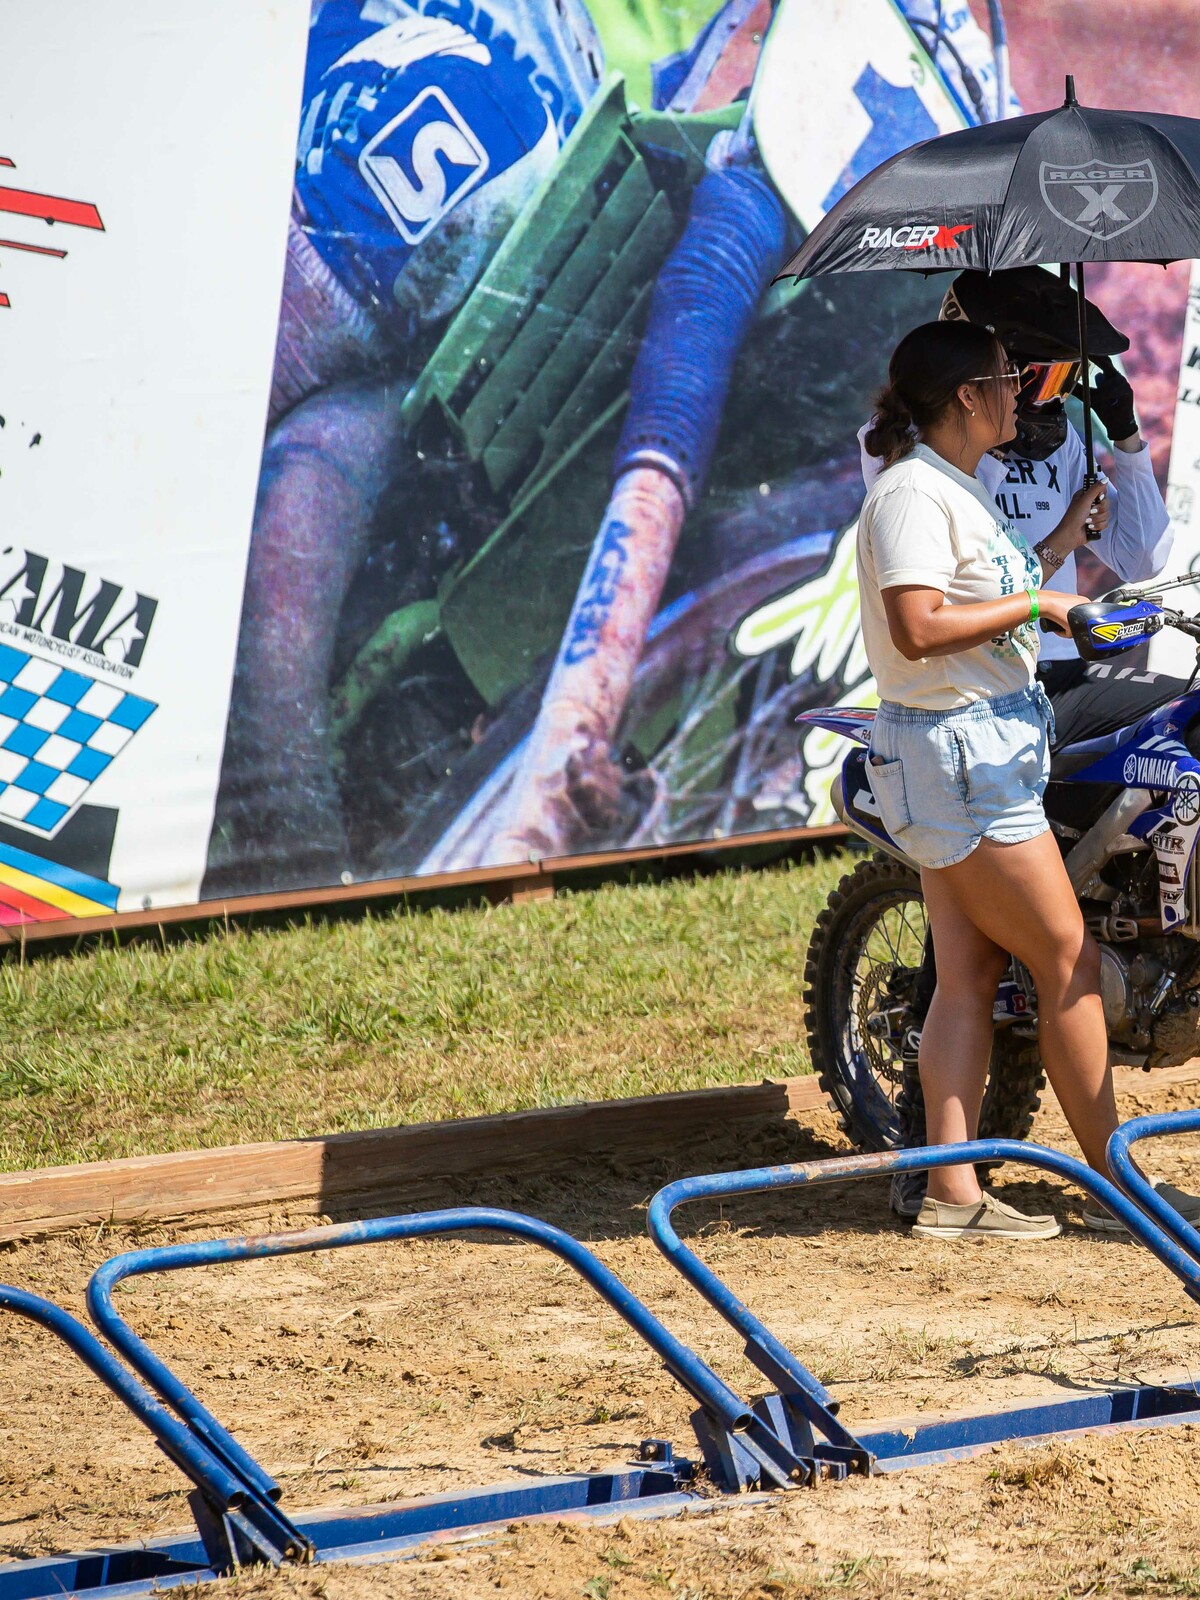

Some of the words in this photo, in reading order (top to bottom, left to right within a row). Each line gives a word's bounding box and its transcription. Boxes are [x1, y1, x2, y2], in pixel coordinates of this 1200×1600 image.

[1049, 169, 1146, 180] RACER
[1072, 184, 1132, 222] X
[1044, 460, 1062, 494] X
[1034, 501, 1051, 511] 1998
[991, 554, 1015, 596] HIGH
[0, 548, 159, 668] AMA
[1117, 623, 1145, 637] CYCRA
[80, 651, 135, 680] ASSOCIATION
[1137, 756, 1178, 788] YAMAHA
[1152, 831, 1186, 852] GYTR
